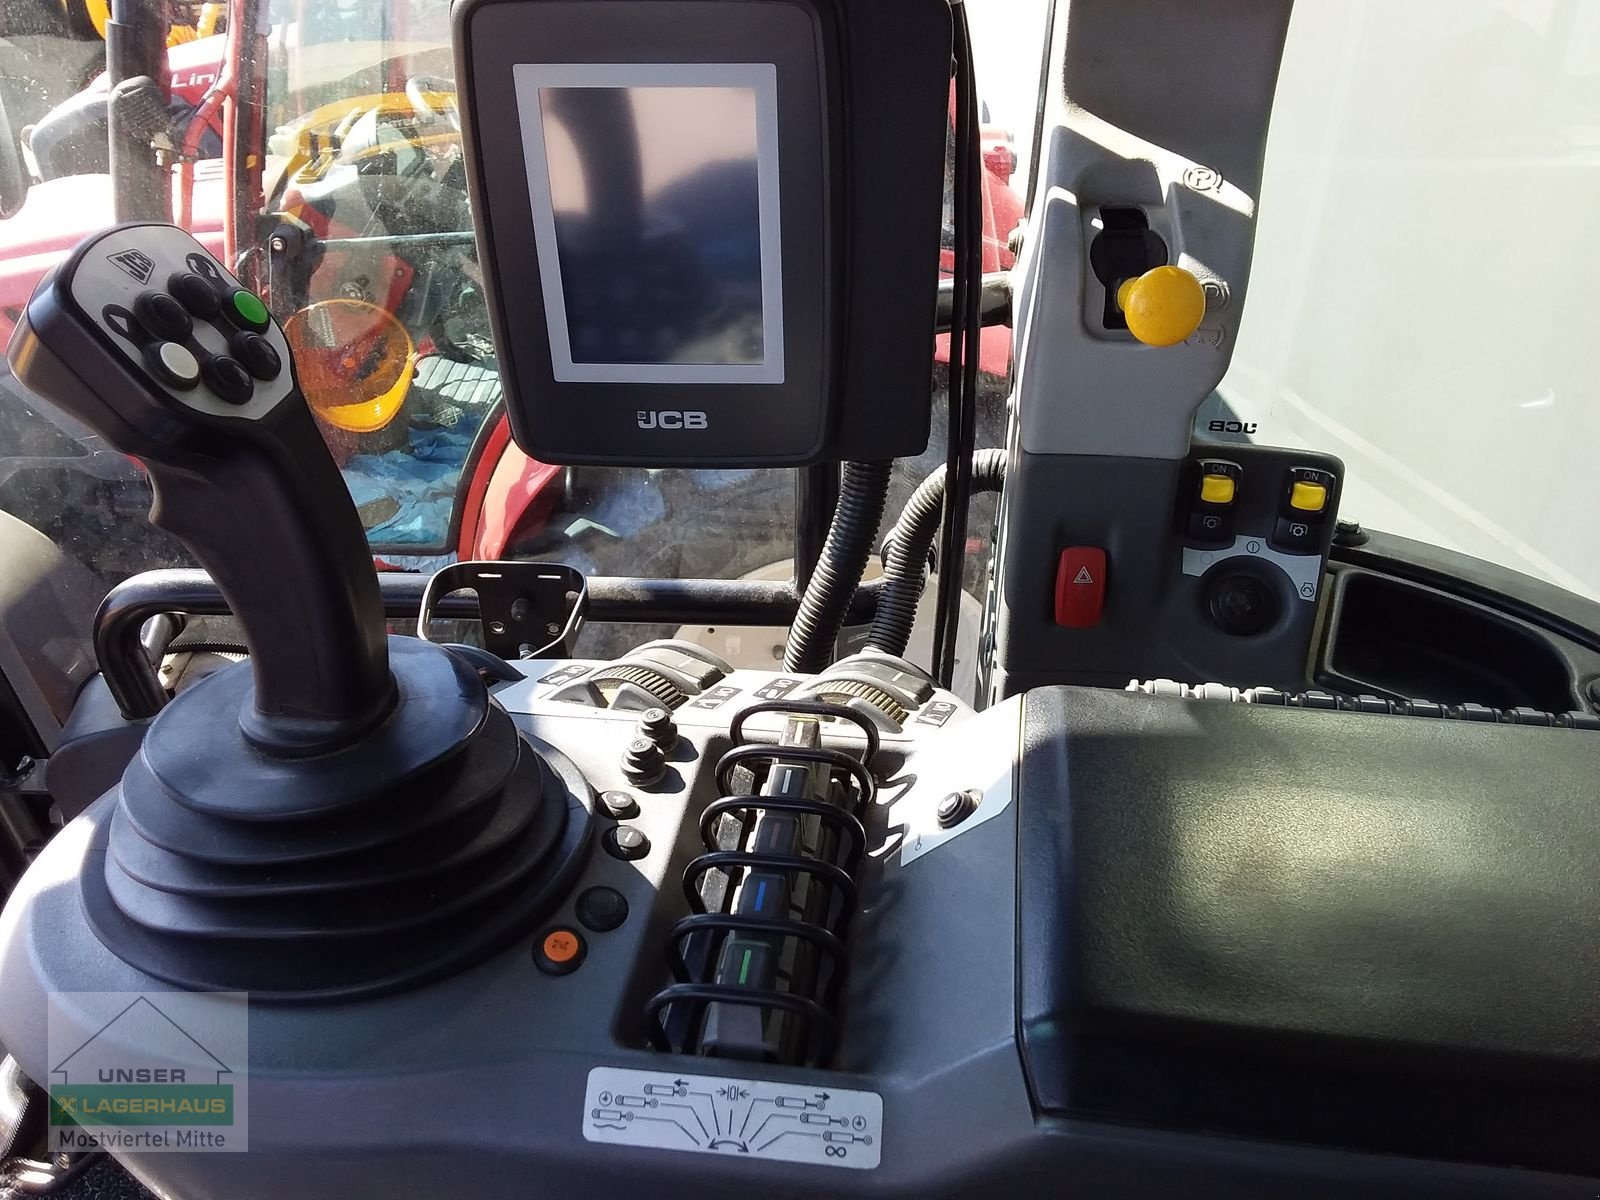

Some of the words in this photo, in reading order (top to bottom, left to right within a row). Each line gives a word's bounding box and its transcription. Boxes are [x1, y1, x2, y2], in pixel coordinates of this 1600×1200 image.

[114, 250, 154, 282] JCB
[637, 410, 709, 429] JCB
[1211, 464, 1228, 473] ON
[1303, 471, 1320, 480] ON
